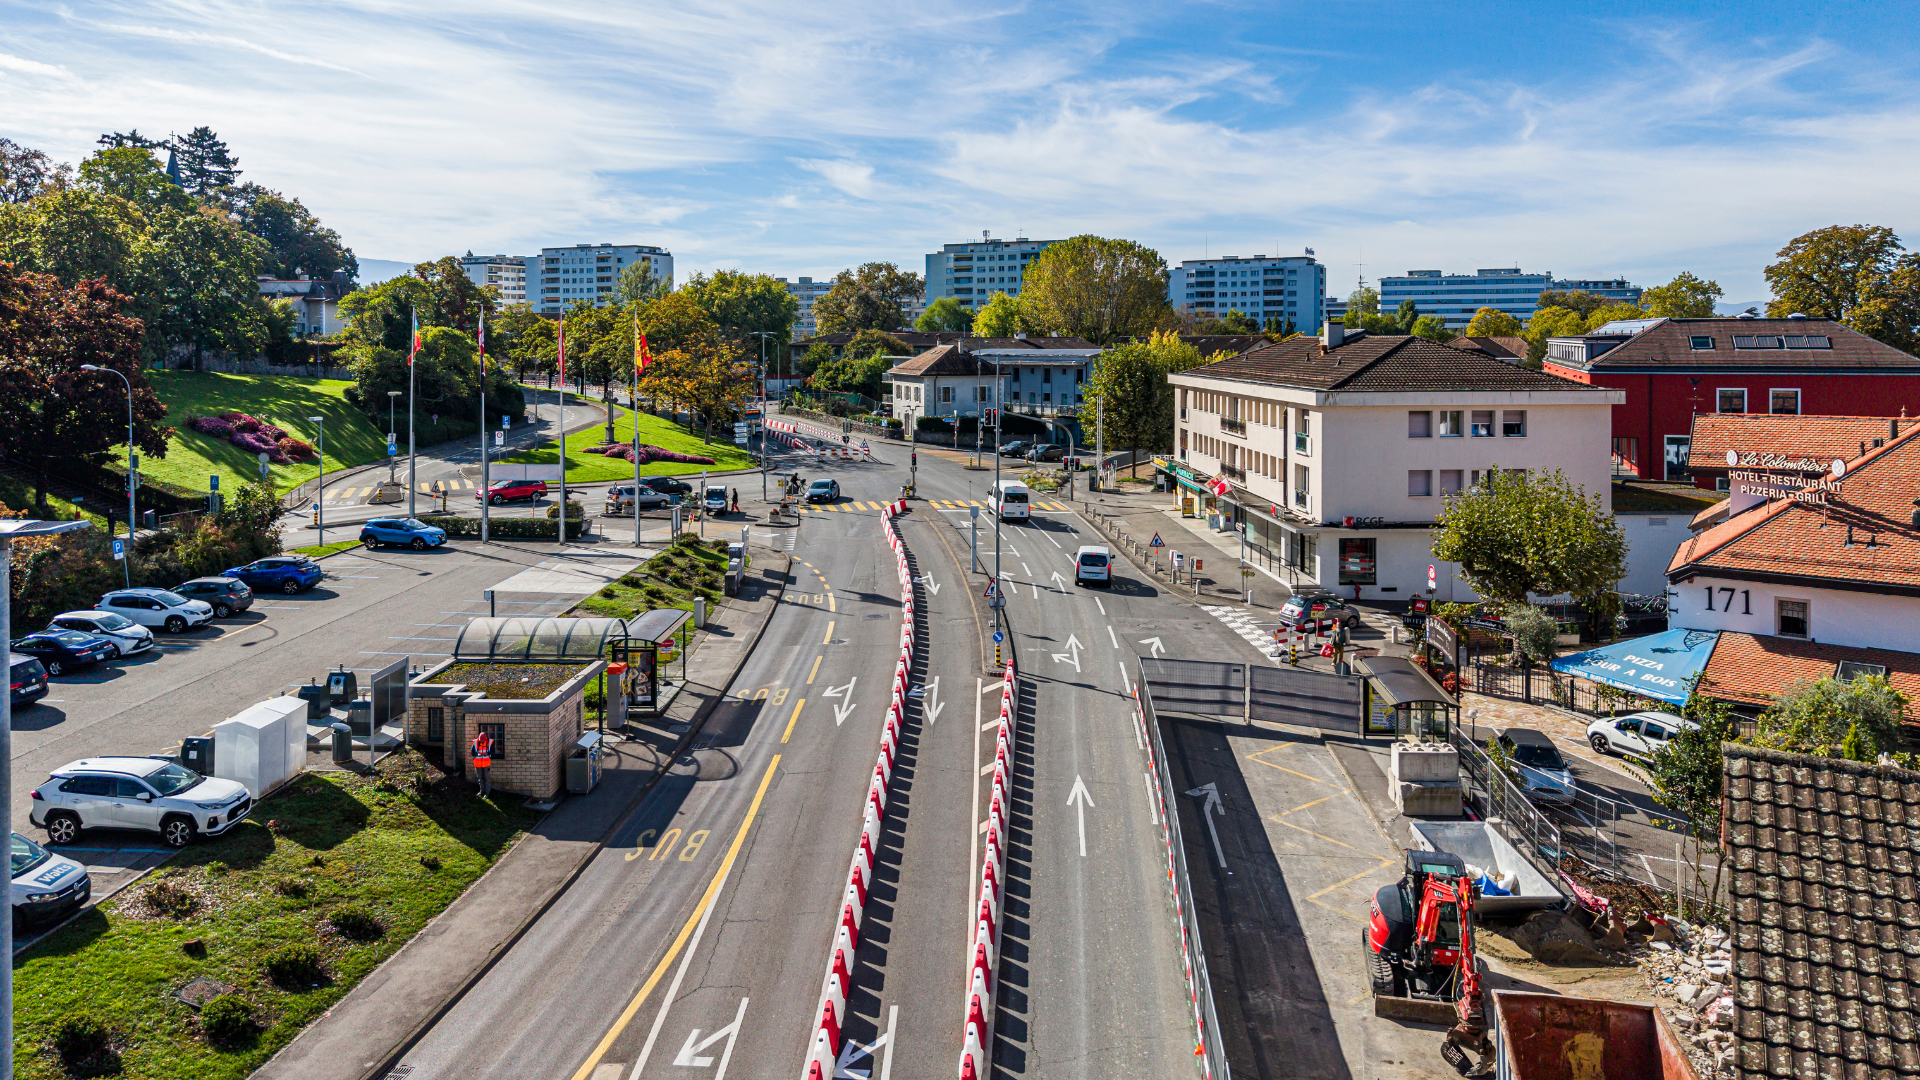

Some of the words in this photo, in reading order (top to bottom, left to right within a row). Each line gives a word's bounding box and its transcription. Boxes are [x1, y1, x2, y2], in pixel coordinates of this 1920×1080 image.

[1740, 452, 1759, 466] La
[1761, 453, 1828, 472] Colombière
[784, 593, 824, 605] BUS
[1704, 585, 1753, 616] 171
[1623, 655, 1664, 671] PIZZA
[1623, 669, 1637, 677] A
[1640, 673, 1678, 688] BOIS
[731, 687, 790, 707] BUS
[624, 827, 711, 862] BUS
[38, 864, 73, 882] Watts
